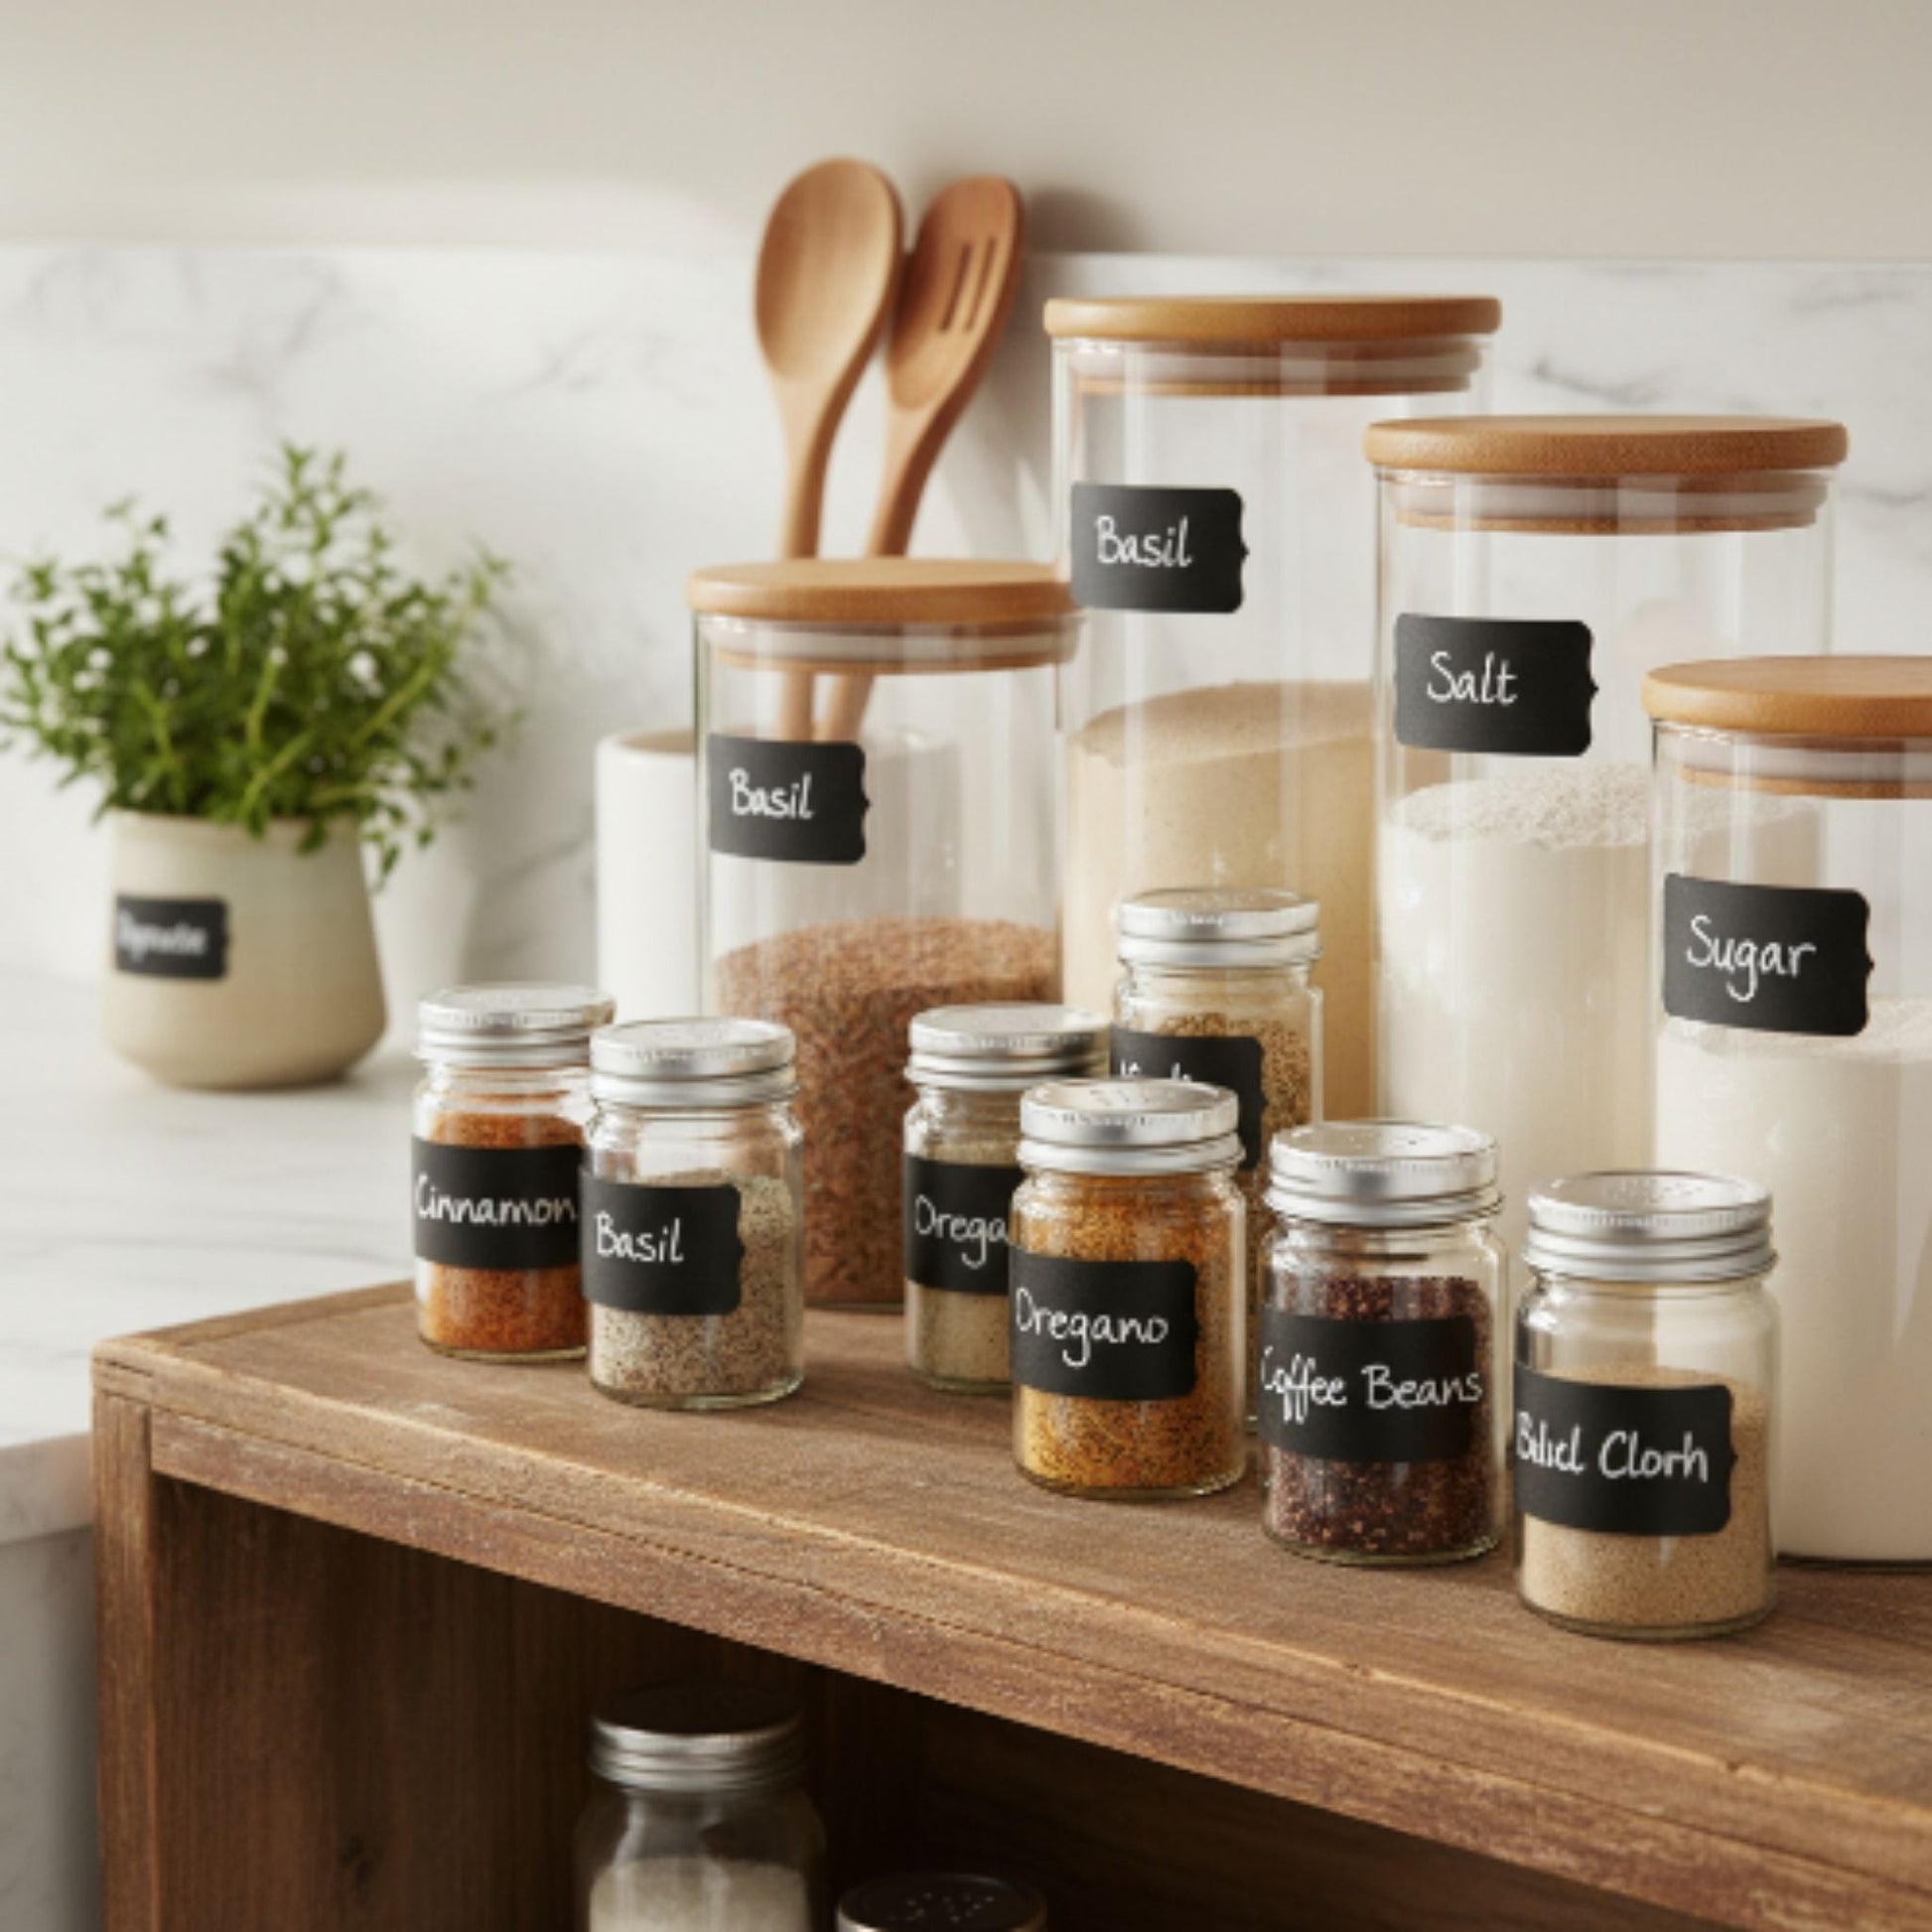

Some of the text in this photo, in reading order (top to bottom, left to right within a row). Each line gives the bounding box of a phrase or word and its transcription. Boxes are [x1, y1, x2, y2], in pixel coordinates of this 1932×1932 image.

[1096, 514, 1193, 569] Basil
[1426, 650, 1518, 706] Salt
[729, 767, 814, 821] Basil
[1686, 914, 1818, 1003] Sugar
[415, 1173, 578, 1225] Cinnamon
[595, 1211, 685, 1265] Basil
[914, 1194, 1010, 1270] Orega
[1016, 1287, 1169, 1369] Oregano
[1361, 1364, 1483, 1410] Beans
